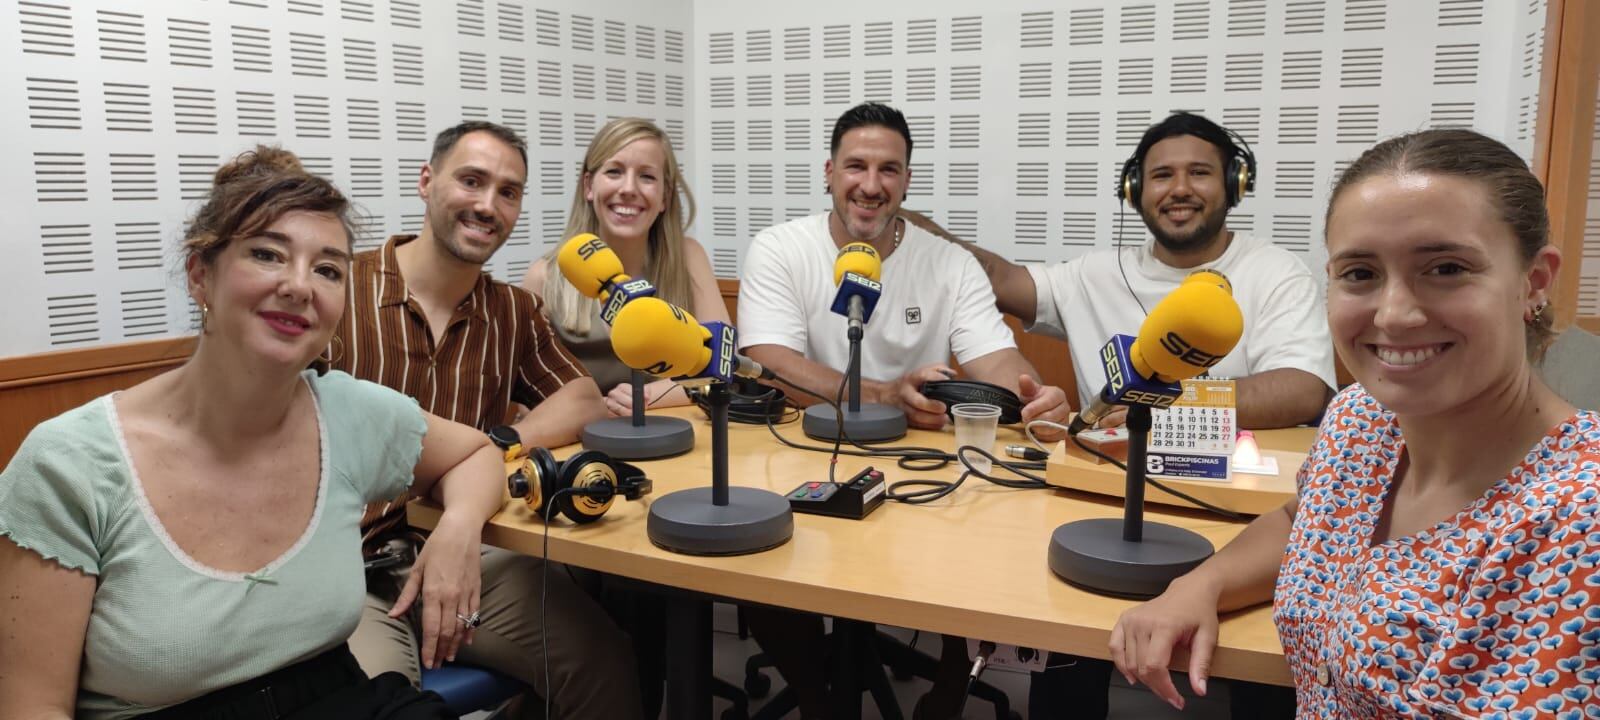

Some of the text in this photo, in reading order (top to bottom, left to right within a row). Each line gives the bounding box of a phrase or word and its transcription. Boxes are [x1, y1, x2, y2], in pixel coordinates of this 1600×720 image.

[578, 239, 607, 261] SE
[623, 280, 653, 293] SER
[847, 272, 880, 291] SER
[604, 290, 627, 324] SER
[720, 326, 734, 378] SER
[1103, 342, 1124, 395] SER
[1120, 390, 1175, 407] SER
[1165, 456, 1219, 464] BRICKPISCINAS
